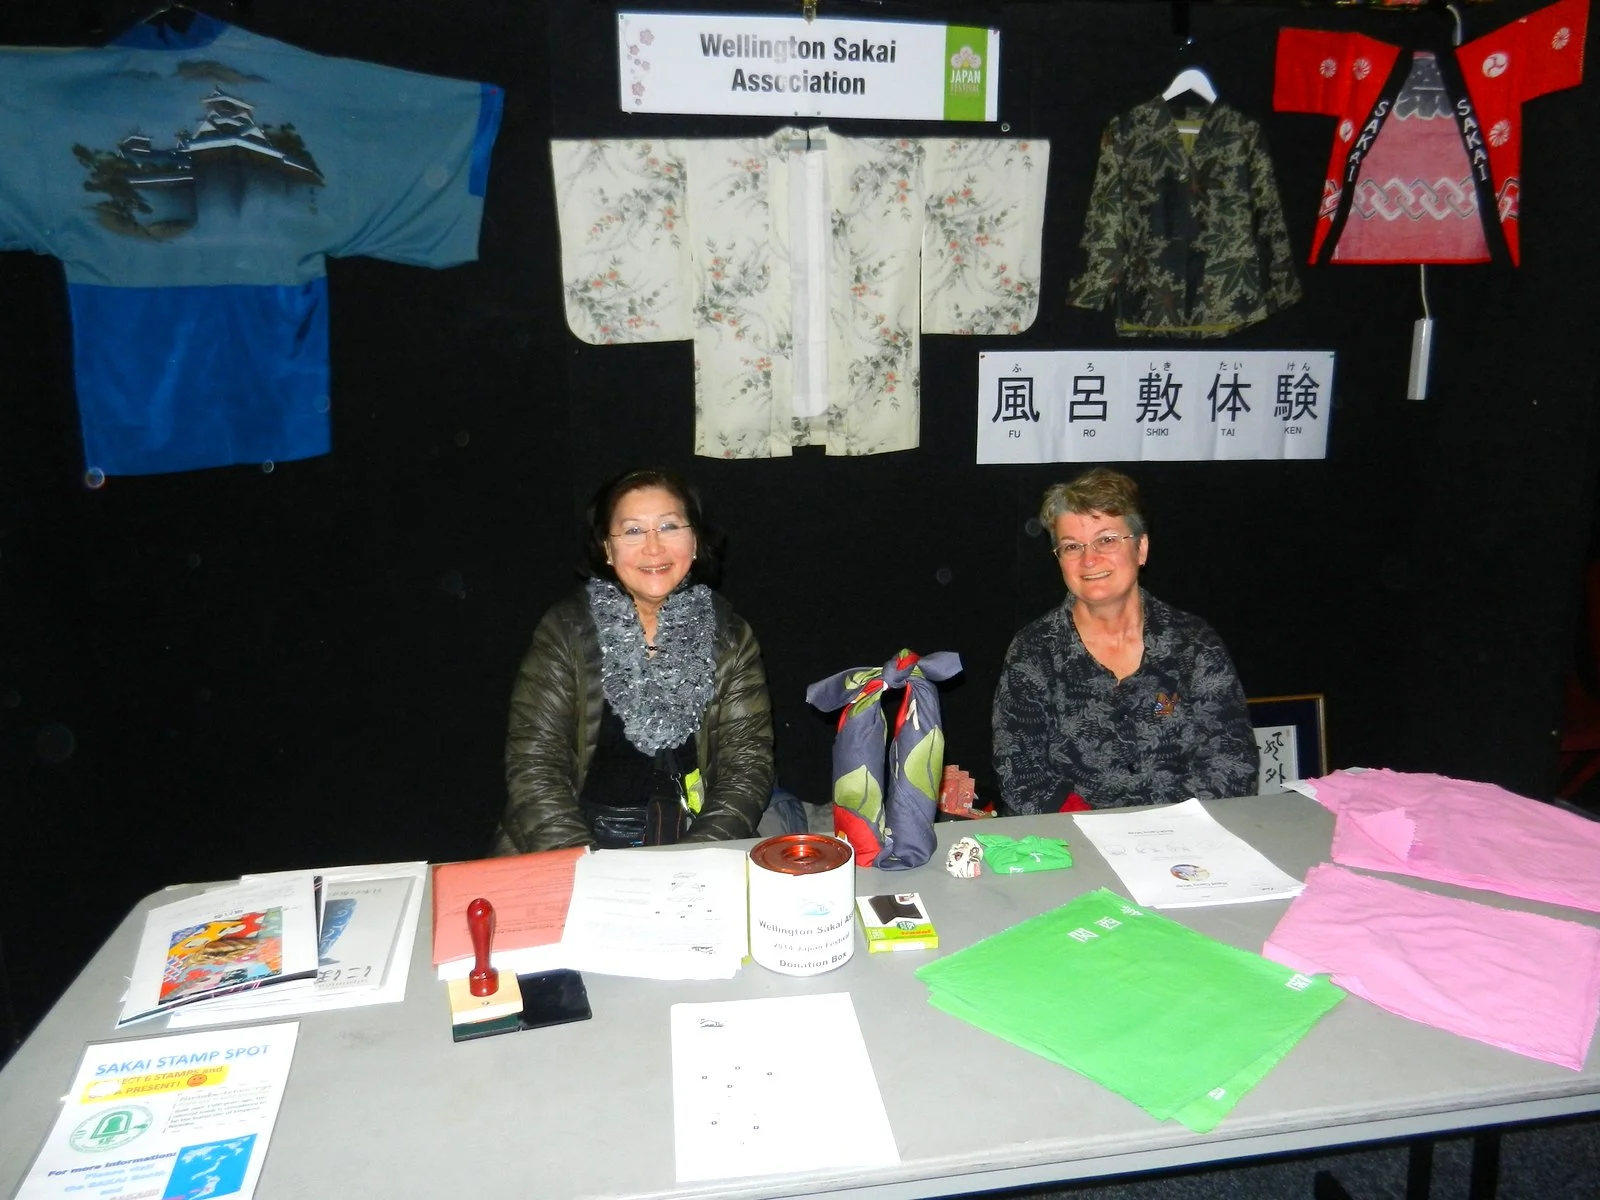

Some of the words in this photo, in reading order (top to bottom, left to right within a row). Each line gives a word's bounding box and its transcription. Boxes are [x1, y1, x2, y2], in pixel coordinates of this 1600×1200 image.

[700, 33, 825, 65] Wellington
[833, 36, 897, 64] Sakai
[731, 68, 865, 96] Association
[949, 70, 981, 86] JAPAN
[1347, 101, 1389, 183] SAKAI
[1457, 99, 1488, 182] SAKAI
[1008, 430, 1022, 439] FU
[1083, 429, 1096, 438] RO
[1145, 427, 1170, 437] SHIKI
[1221, 428, 1236, 437] TAI
[1284, 426, 1302, 436] KEN
[758, 918, 813, 936] Wellington
[816, 918, 843, 934] Sakai
[779, 959, 829, 969] Donation
[831, 951, 847, 963] Box
[95, 1058, 151, 1077] SAKAI
[156, 1051, 220, 1069] STAMP
[224, 1044, 271, 1061] SPOT
[202, 1065, 223, 1075] and
[70, 1165, 103, 1174] more
